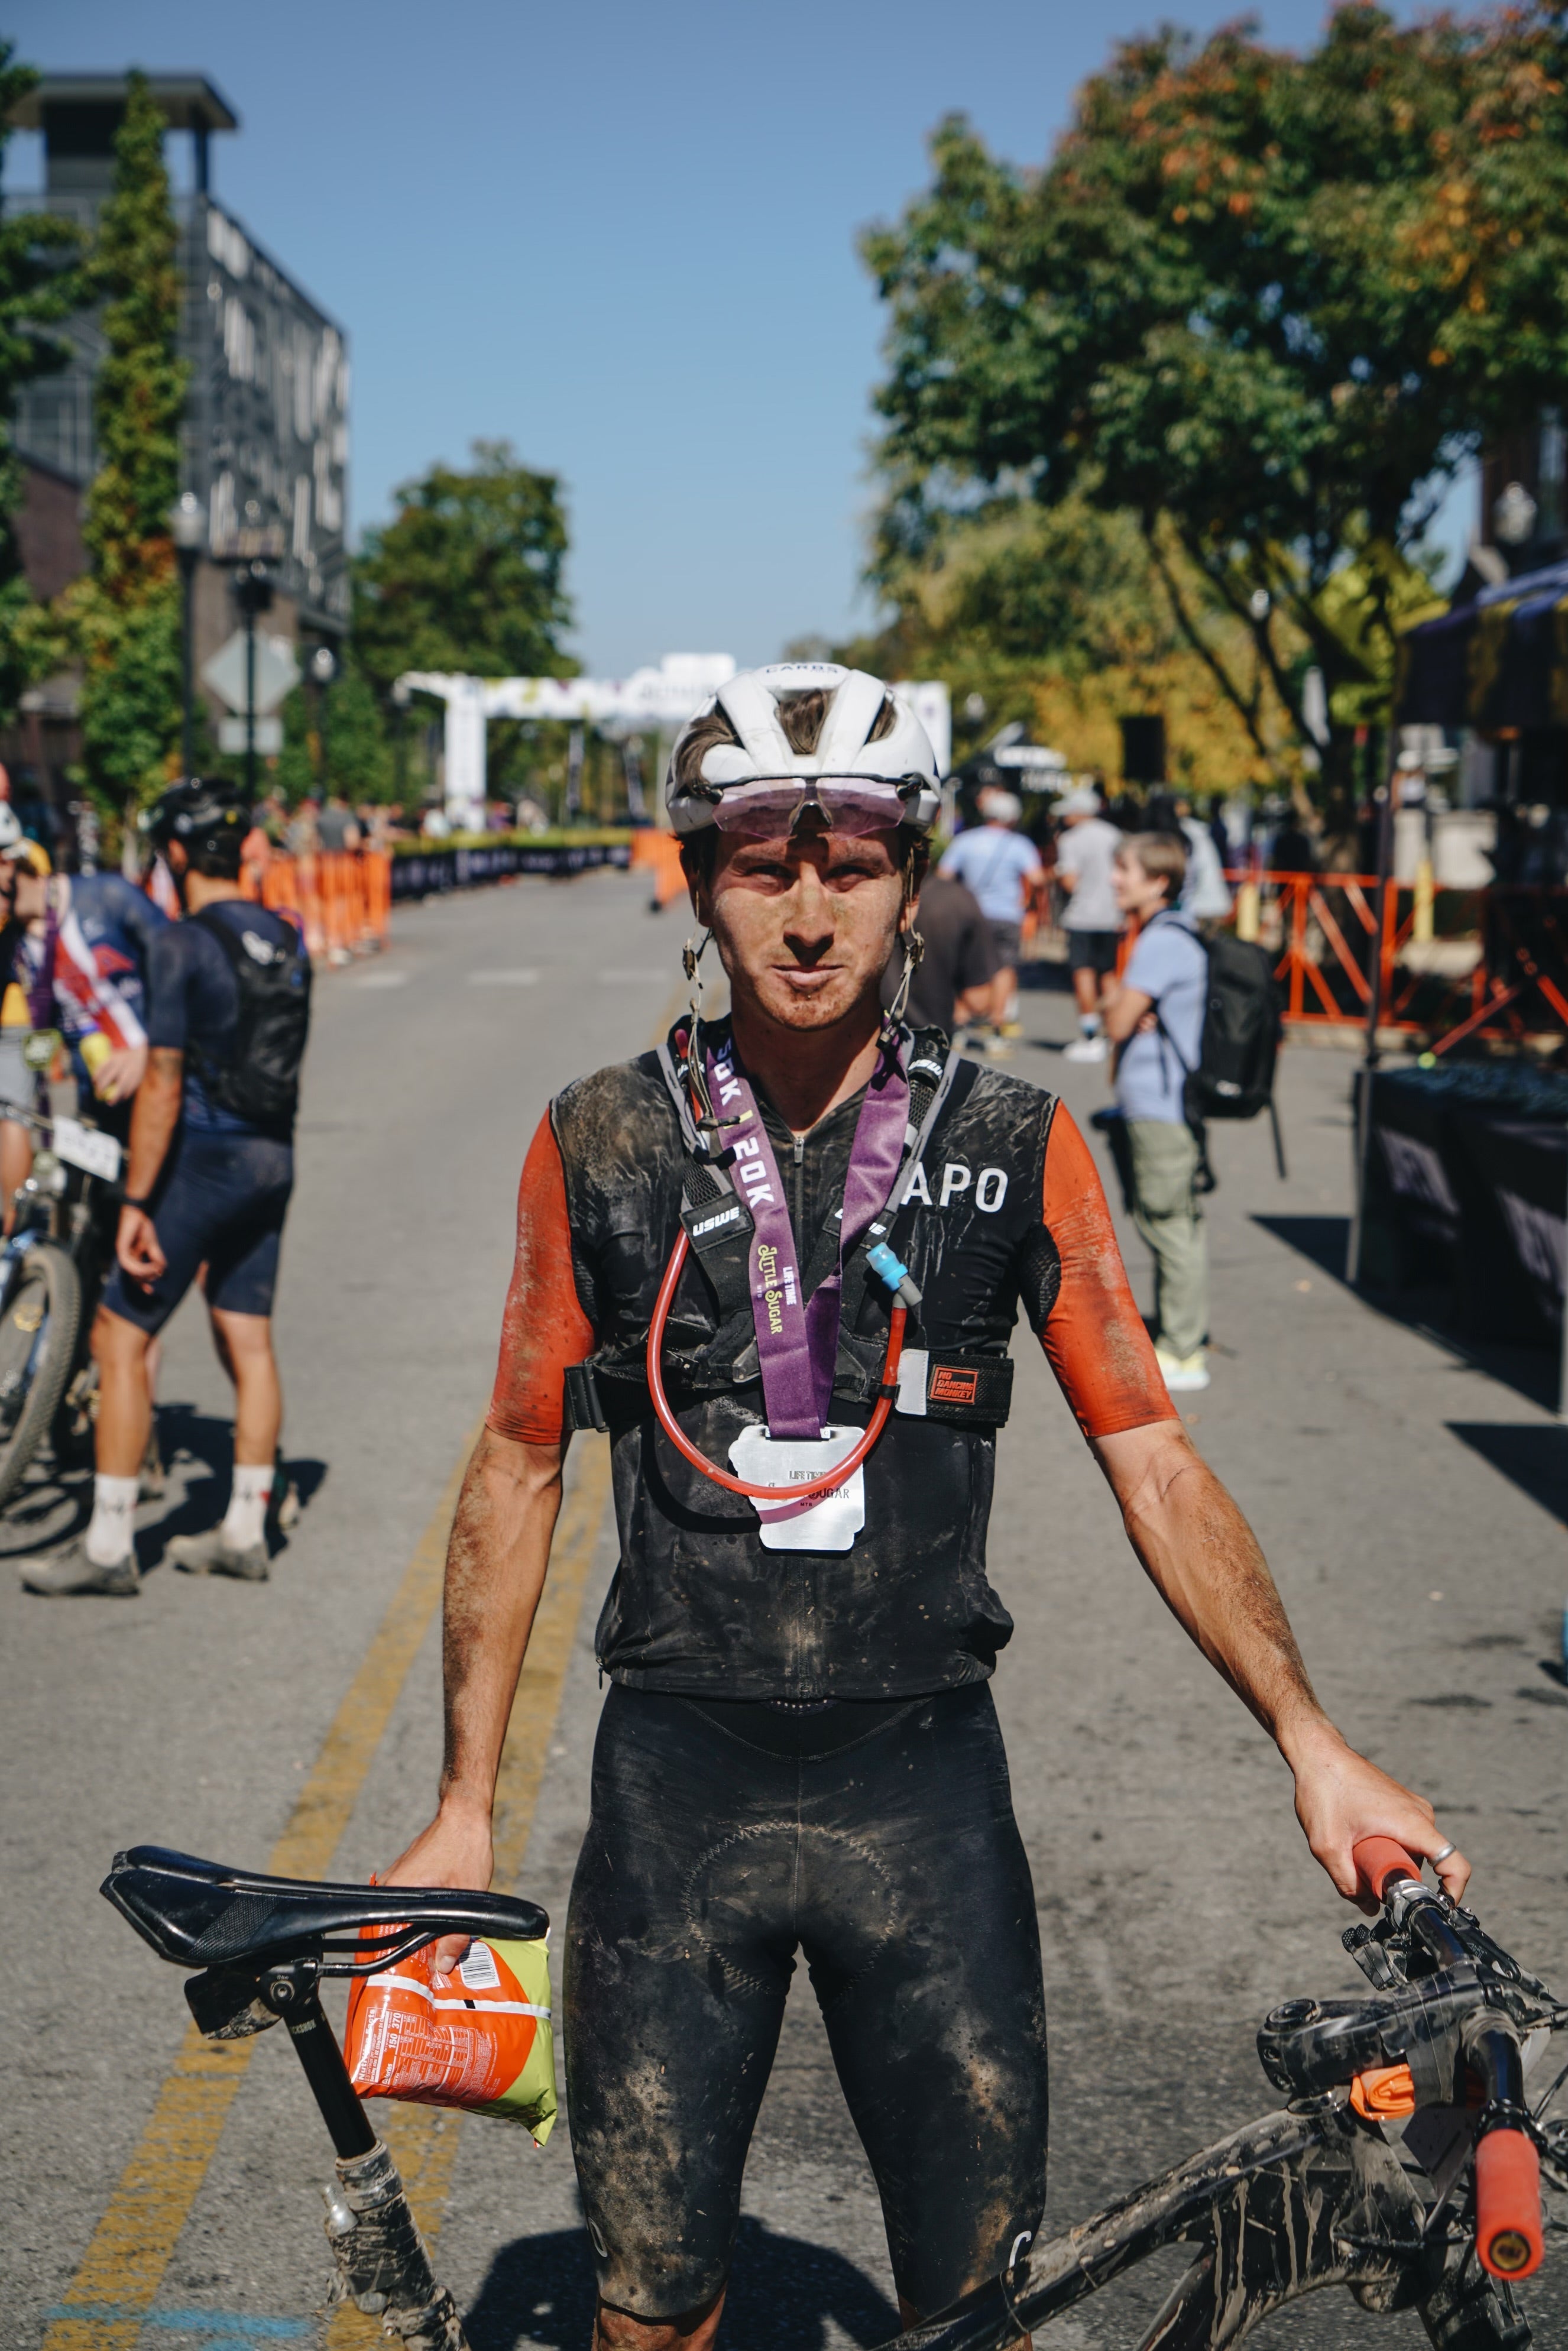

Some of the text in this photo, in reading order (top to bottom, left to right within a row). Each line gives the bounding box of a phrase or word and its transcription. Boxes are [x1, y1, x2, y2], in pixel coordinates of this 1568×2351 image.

[733, 1136, 775, 1209] 20K
[900, 1161, 1009, 1213] APO
[692, 1206, 740, 1236] USWE
[757, 1245, 783, 1335] LITTLE SUGAR
[782, 1266, 797, 1306] LIFE TIME
[936, 1379, 974, 1391] DANCING
[938, 1371, 953, 1380] NO
[934, 1387, 972, 1399] MONKEY
[789, 1471, 805, 1480] LIFE
[808, 1488, 850, 1500] SUGAR
[381, 2012, 401, 2084] Calories 150 370
